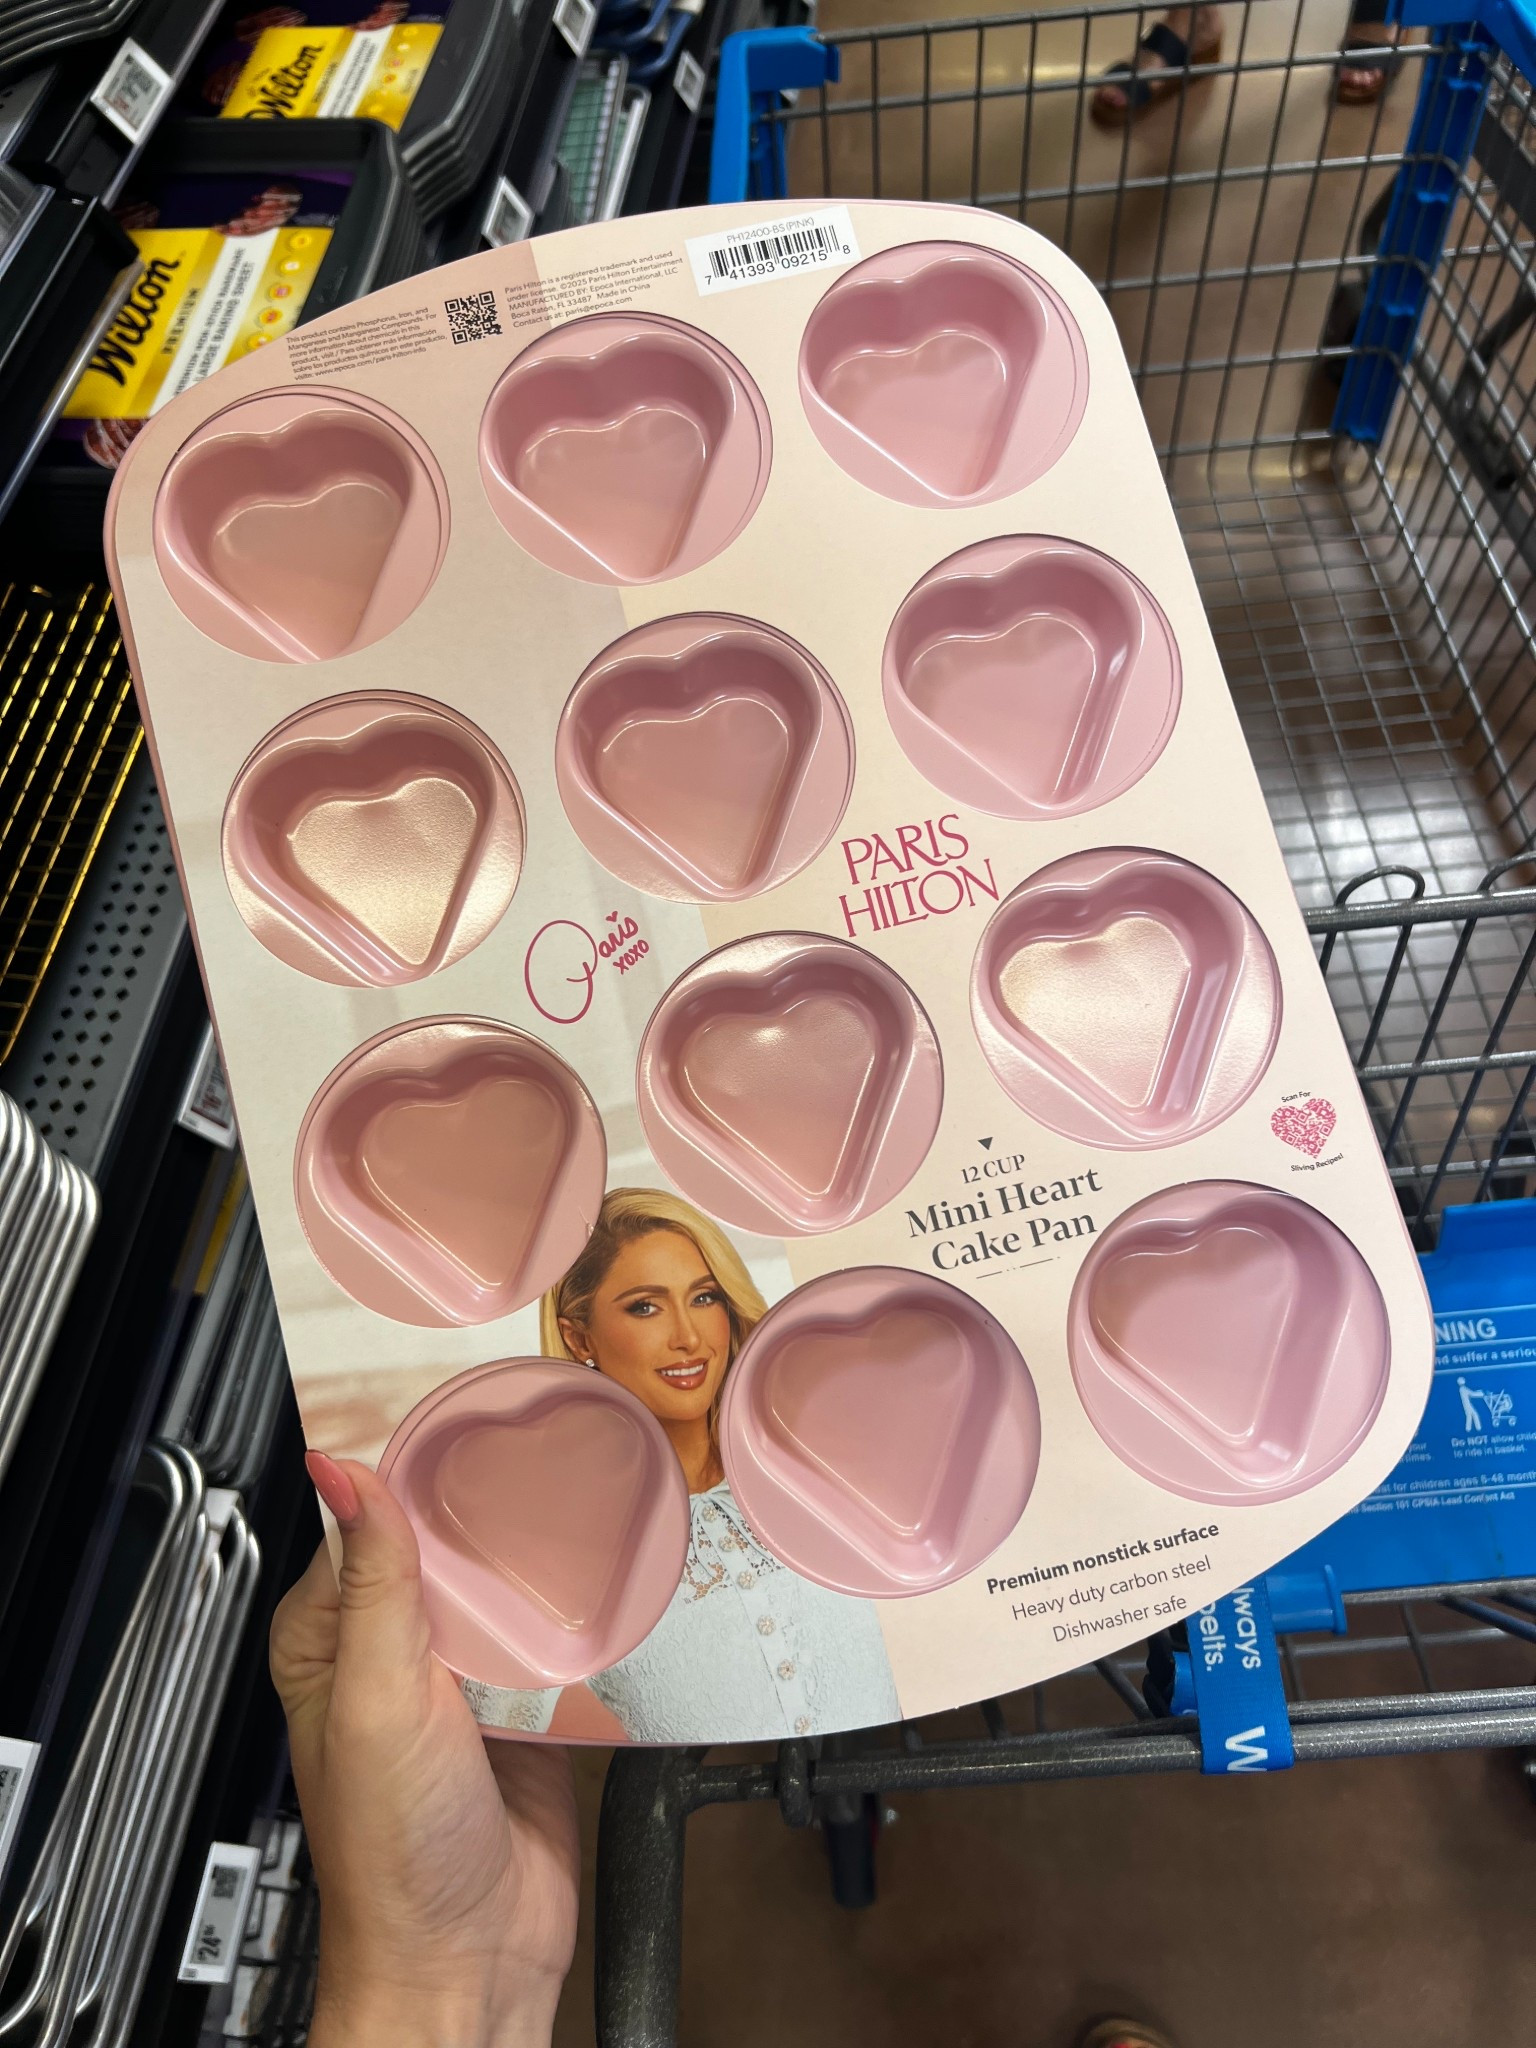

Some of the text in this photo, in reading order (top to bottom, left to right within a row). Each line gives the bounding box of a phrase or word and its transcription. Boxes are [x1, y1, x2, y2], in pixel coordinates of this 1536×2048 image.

[726, 216, 815, 244] PH12400-BS (PINK)
[505, 285, 522, 294] Paris
[523, 281, 546, 289] Hilton
[561, 267, 599, 284] registered
[600, 259, 638, 272] trademark
[639, 254, 653, 263] and
[654, 251, 673, 260] used
[507, 293, 528, 302] under
[560, 279, 587, 289] ©2025
[589, 275, 606, 283] Paris
[607, 270, 630, 279] Hilton
[631, 258, 683, 274] Entertainment
[705, 244, 851, 286] 7 41393 09215 8
[509, 291, 575, 311] MANUFACTURED
[590, 283, 614, 292] Epoca
[615, 271, 663, 286] International,
[664, 267, 678, 275] LLC
[511, 311, 530, 319] Boca
[567, 295, 591, 306] 33487
[597, 290, 619, 299] Made
[628, 284, 650, 292] China
[288, 339, 327, 351] Manganese
[328, 334, 341, 342] and
[341, 327, 380, 339] Manganese
[301, 330, 328, 341] product
[328, 324, 356, 335] contains
[356, 315, 398, 328] Phosphorus,
[415, 307, 428, 315] and
[513, 316, 543, 328] Contact
[291, 356, 320, 367] product,
[356, 342, 381, 351] obtener
[309, 343, 346, 354] information
[347, 336, 366, 345] about
[368, 329, 400, 341] chemicals
[324, 355, 358, 367] productos
[415, 335, 447, 347] producto,
[841, 814, 968, 885] PARIS
[838, 858, 999, 937] HILTON
[1281, 1094, 1298, 1103] Scan
[961, 1154, 1025, 1184] 12 CUP
[1315, 1152, 1344, 1168] Recipes!
[904, 1168, 1103, 1238] Mini Heart
[931, 1213, 1098, 1270] Cake Pan
[1452, 1351, 1488, 1364] suffer
[986, 1523, 1220, 1594] Premium nonstick surface
[1011, 1554, 1212, 1621] Heavy duty carbon steel
[1052, 1594, 1188, 1642] Dishwasher safe
